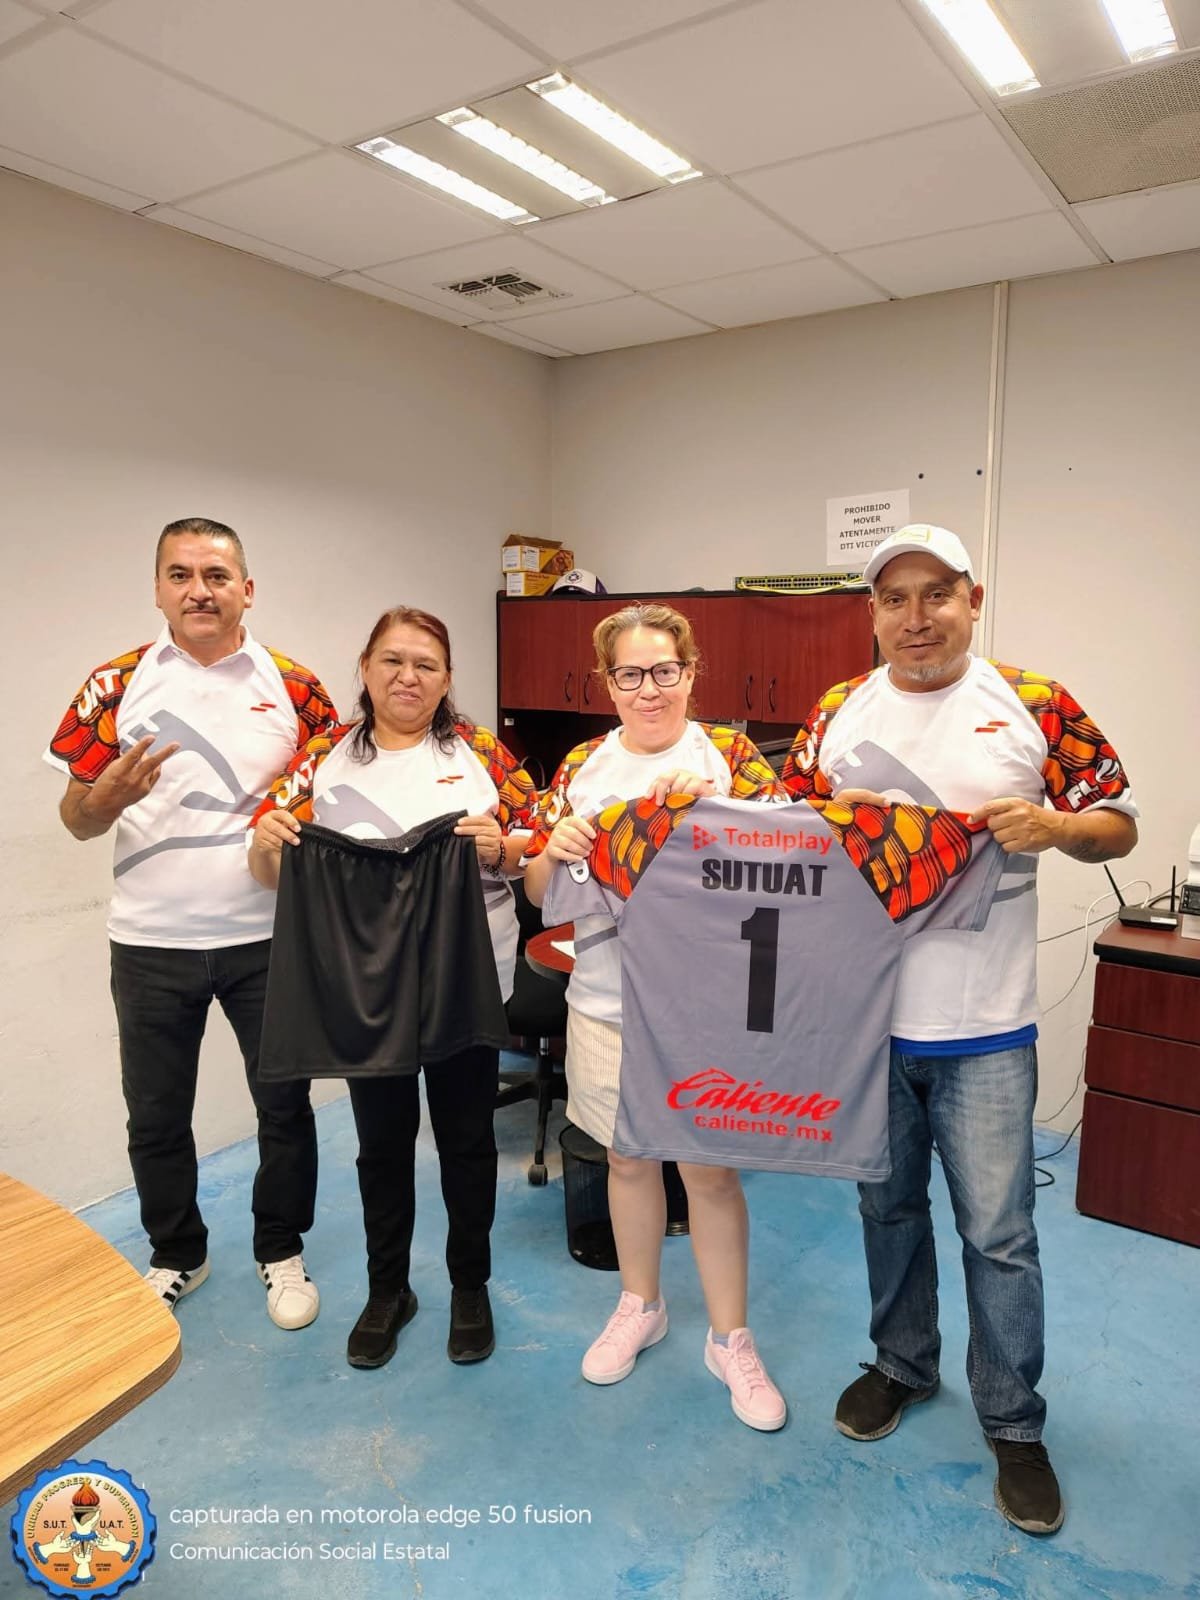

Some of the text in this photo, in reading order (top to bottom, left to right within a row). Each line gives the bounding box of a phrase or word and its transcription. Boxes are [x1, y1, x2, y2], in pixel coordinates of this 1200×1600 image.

[844, 503, 891, 514] PROHIBIDO
[853, 516, 881, 525] MOVER
[839, 527, 896, 538] ATENTAMENTE
[840, 542, 854, 550] DTI
[723, 827, 833, 855] Totalplay
[702, 859, 828, 897] SUTUAT
[740, 907, 780, 1033] 1
[667, 1068, 841, 1121] Caliente
[695, 1115, 834, 1143] caliente.mx
